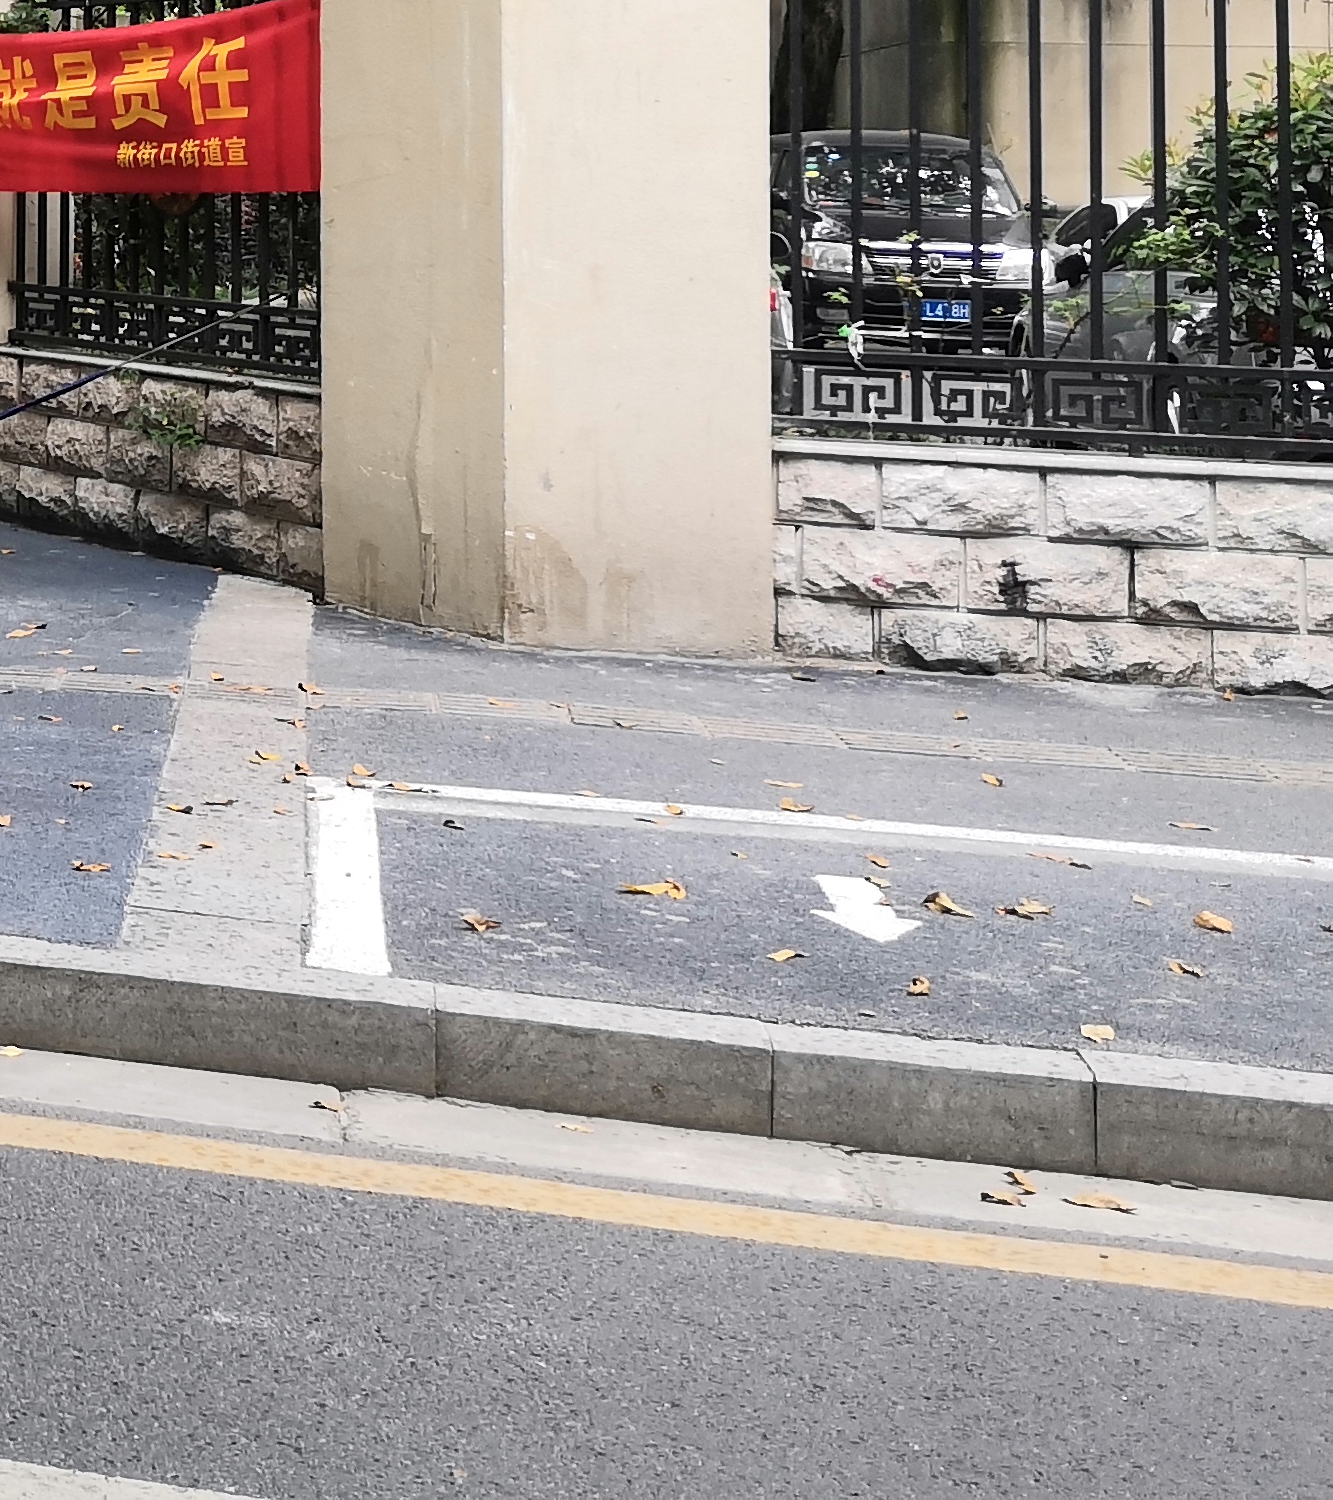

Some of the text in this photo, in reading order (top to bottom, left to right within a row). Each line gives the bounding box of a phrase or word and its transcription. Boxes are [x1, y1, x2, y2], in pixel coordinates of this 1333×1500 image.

[115, 136, 249, 169] 新街口街道宣
